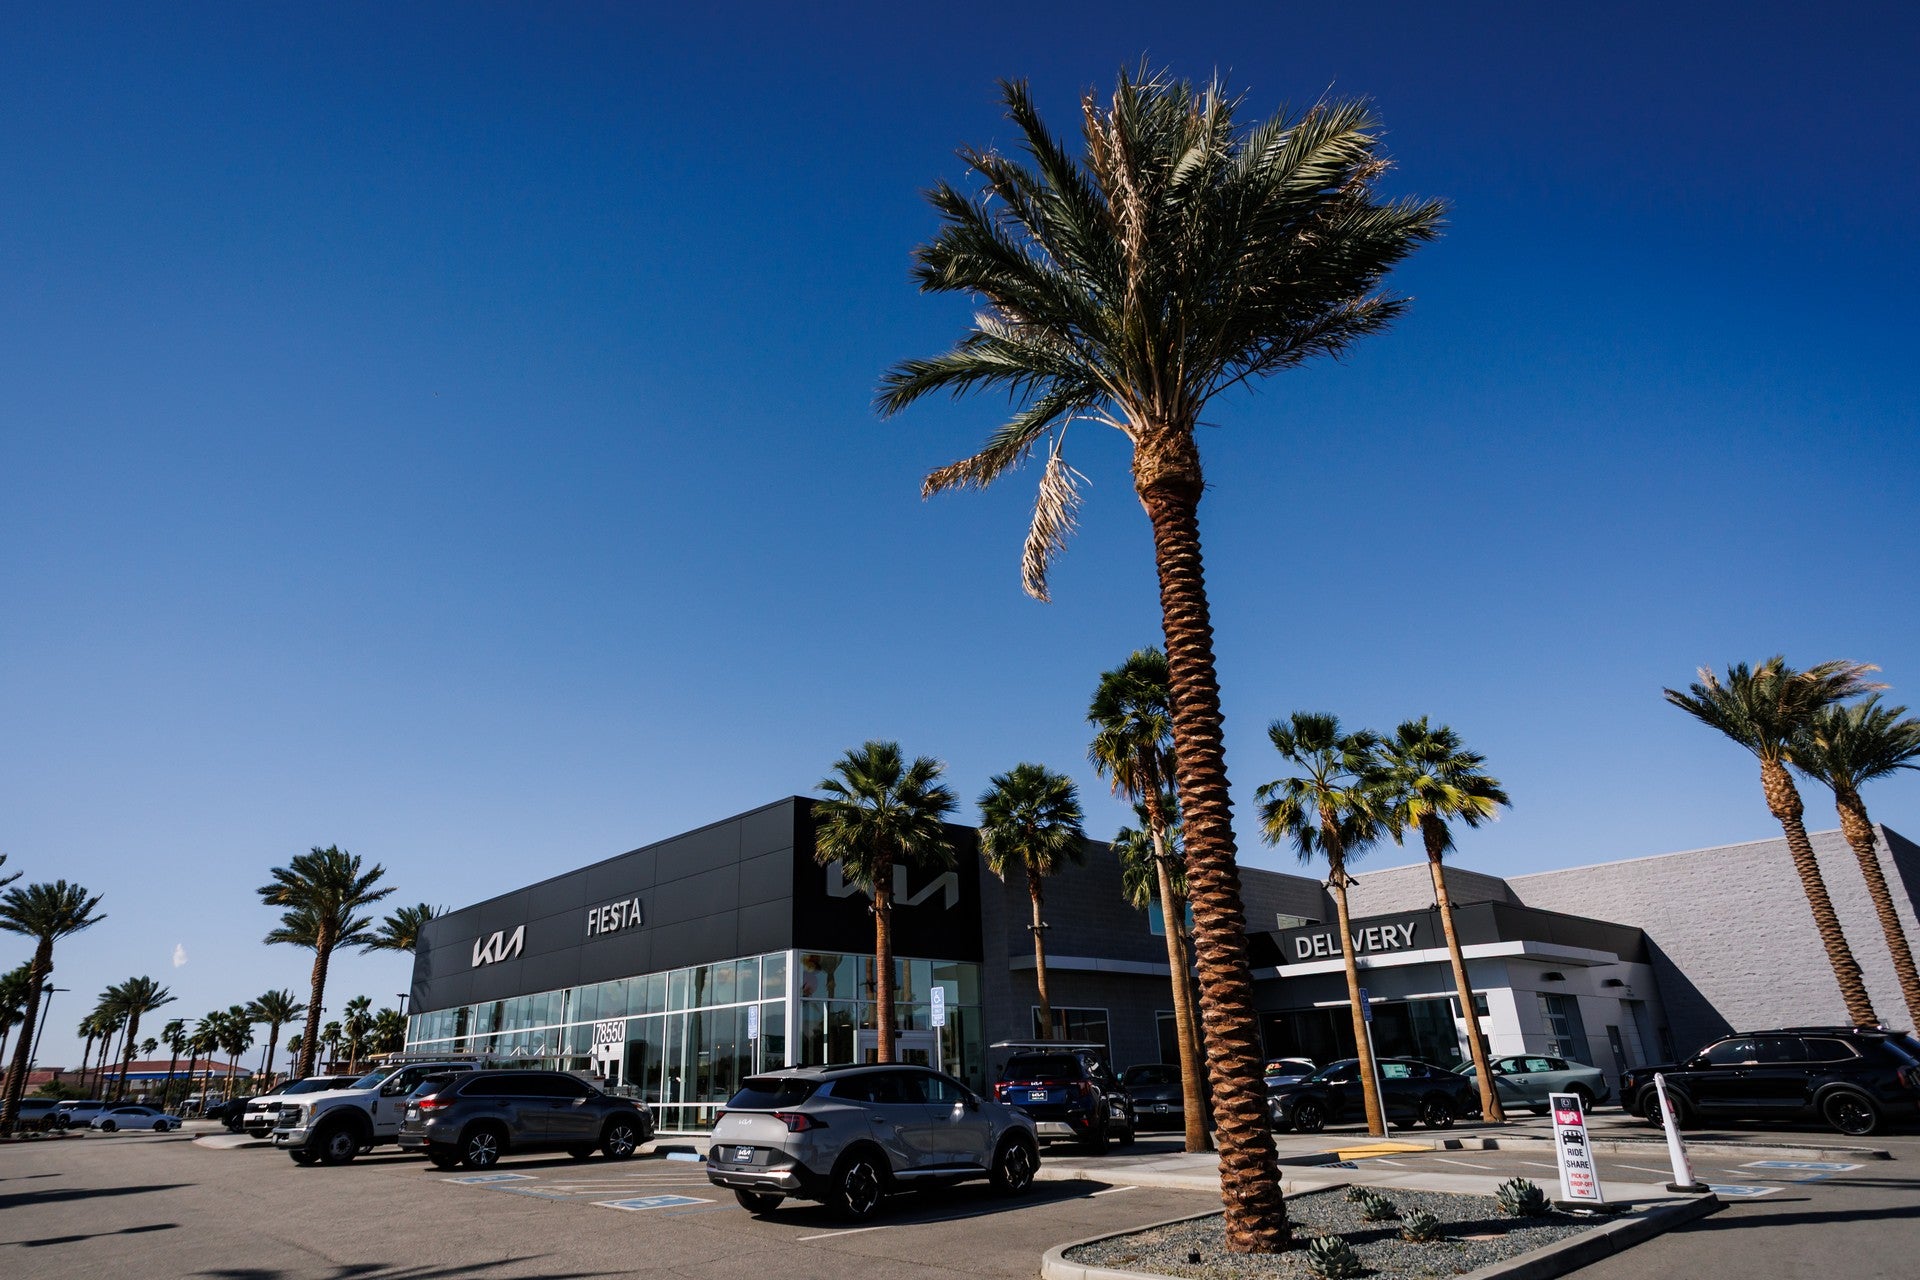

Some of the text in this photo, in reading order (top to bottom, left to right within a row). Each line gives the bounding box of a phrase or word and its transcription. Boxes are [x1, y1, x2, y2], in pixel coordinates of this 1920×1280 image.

[587, 897, 641, 936] FIESTA
[472, 925, 526, 968] KIA
[1295, 922, 1415, 958] DELVERY
[596, 1021, 624, 1043] 78550
[1559, 1111, 1579, 1124] lyft
[1567, 1148, 1584, 1157] RIDE
[1566, 1160, 1590, 1169] SHARE
